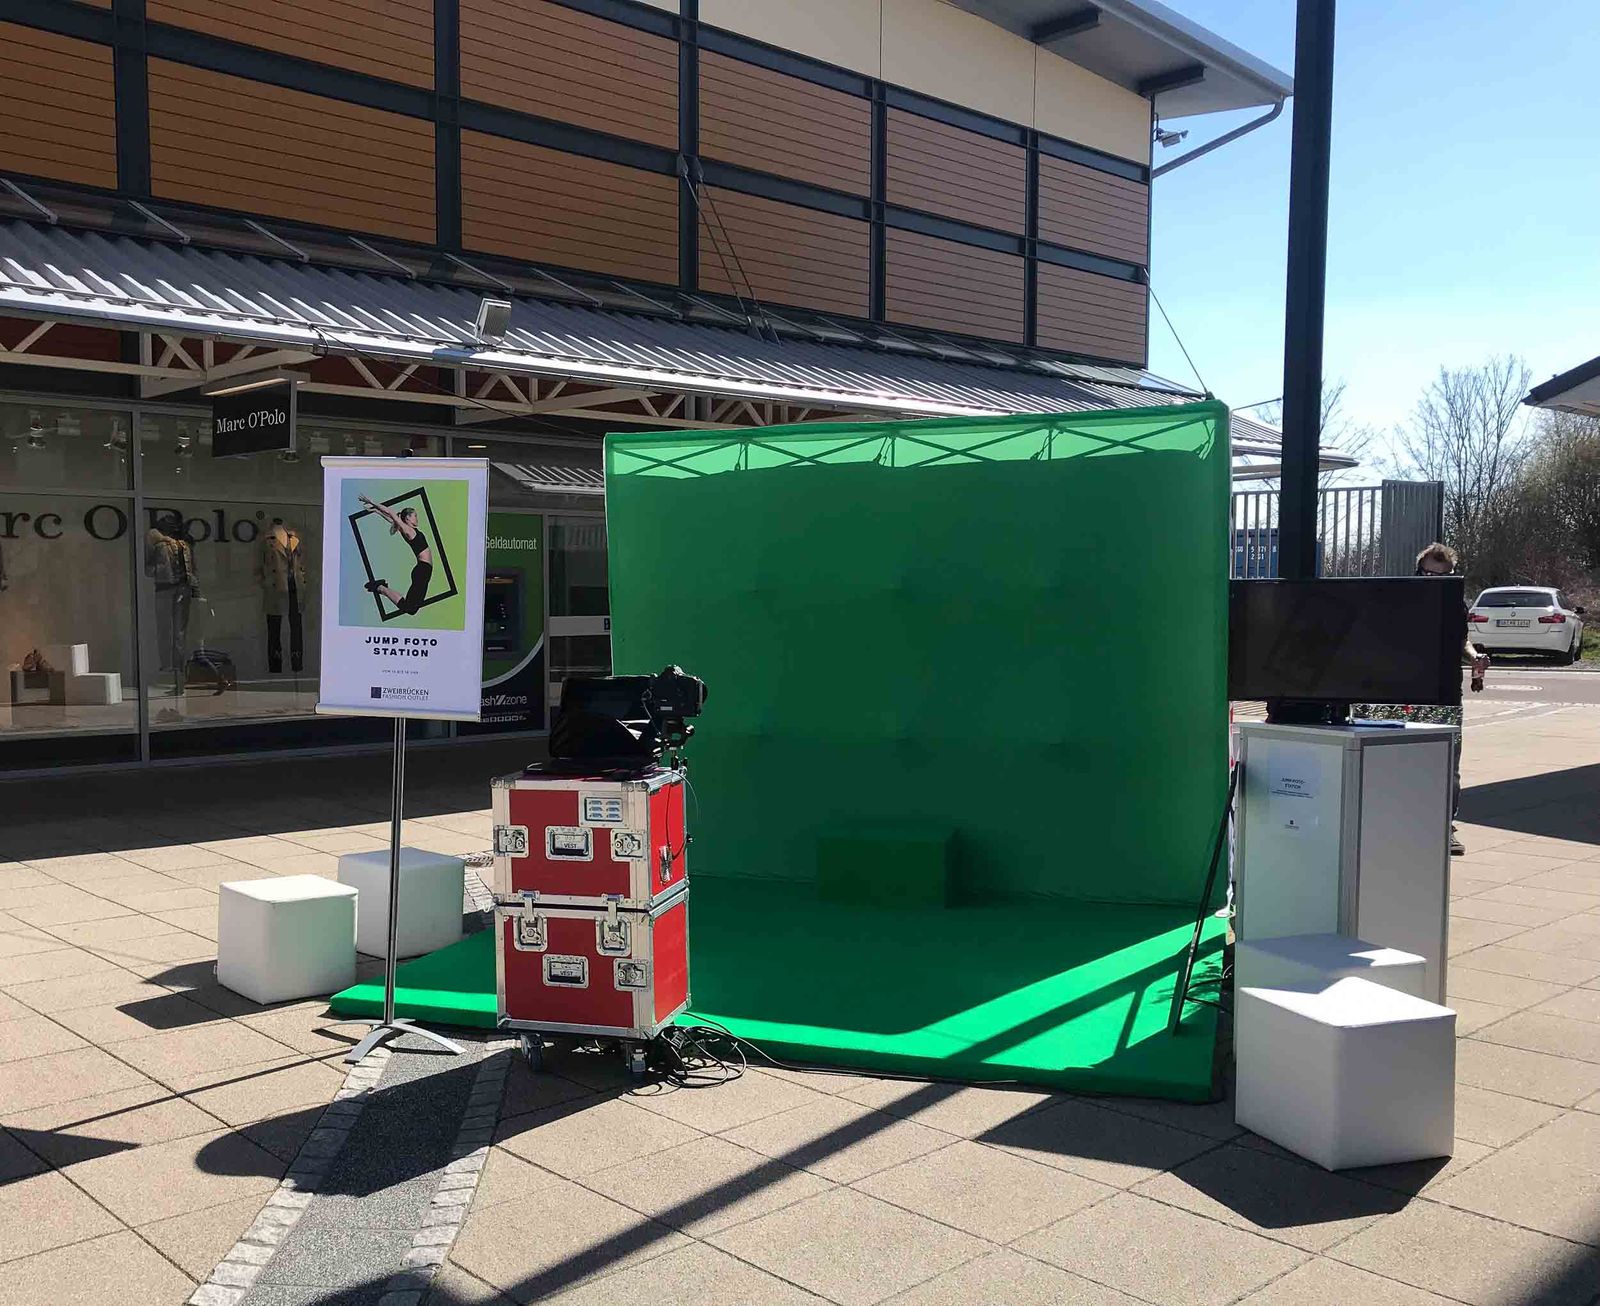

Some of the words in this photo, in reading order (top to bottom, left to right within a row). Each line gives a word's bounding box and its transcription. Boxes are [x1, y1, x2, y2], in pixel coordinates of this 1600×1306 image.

[216, 417, 245, 434] Marc
[248, 408, 286, 429] O'Polo
[365, 636, 399, 645] JUMP
[404, 637, 438, 647] FOTO
[373, 647, 429, 658] STATION
[382, 687, 429, 696] ZWEIBRÜCKEN
